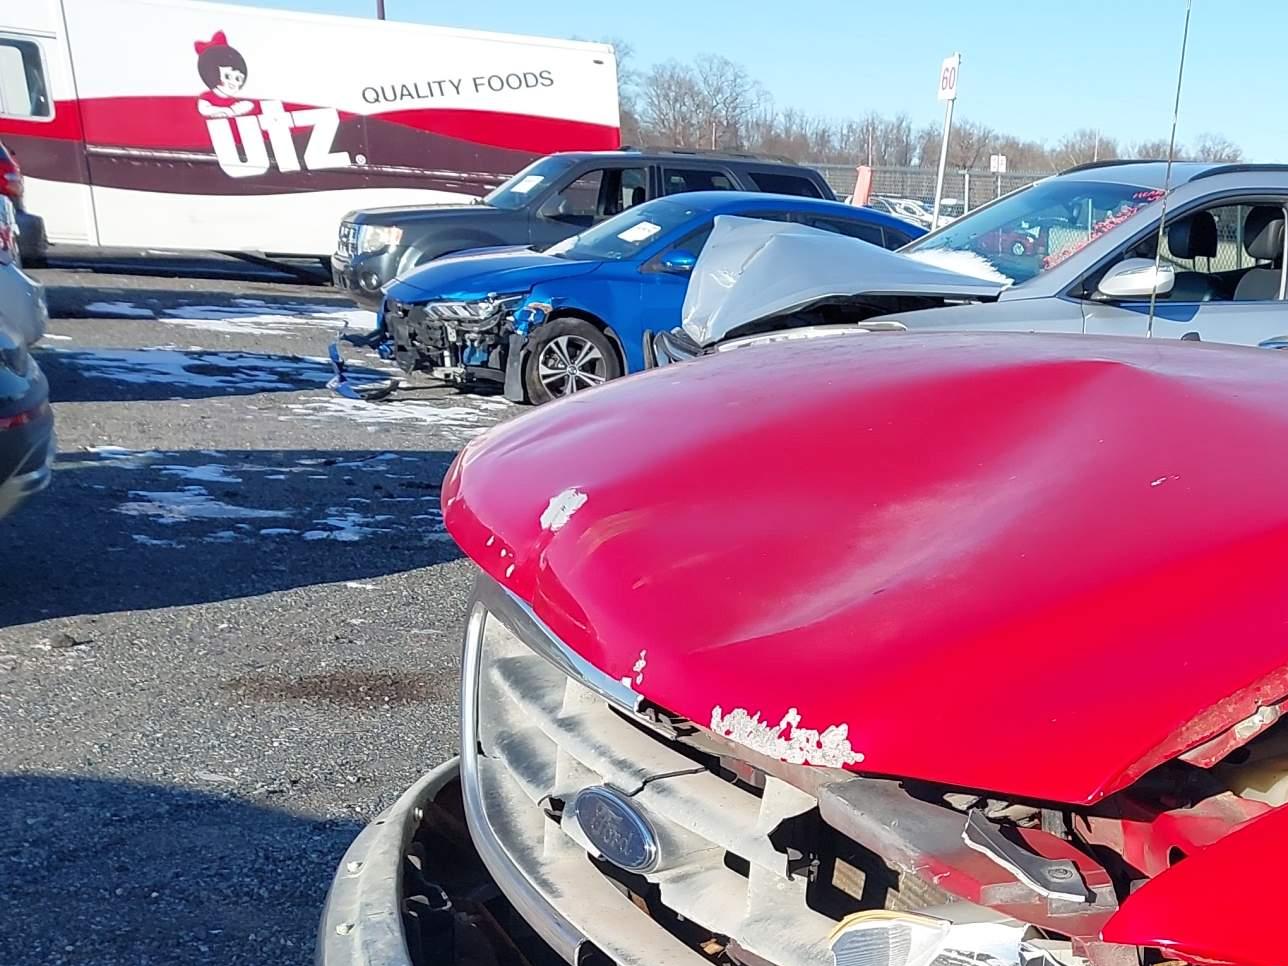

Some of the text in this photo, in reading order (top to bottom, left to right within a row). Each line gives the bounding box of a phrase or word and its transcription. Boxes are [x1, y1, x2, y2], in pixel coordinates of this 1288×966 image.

[361, 70, 555, 104] QUALITY FOODS
[941, 66, 956, 90] 60
